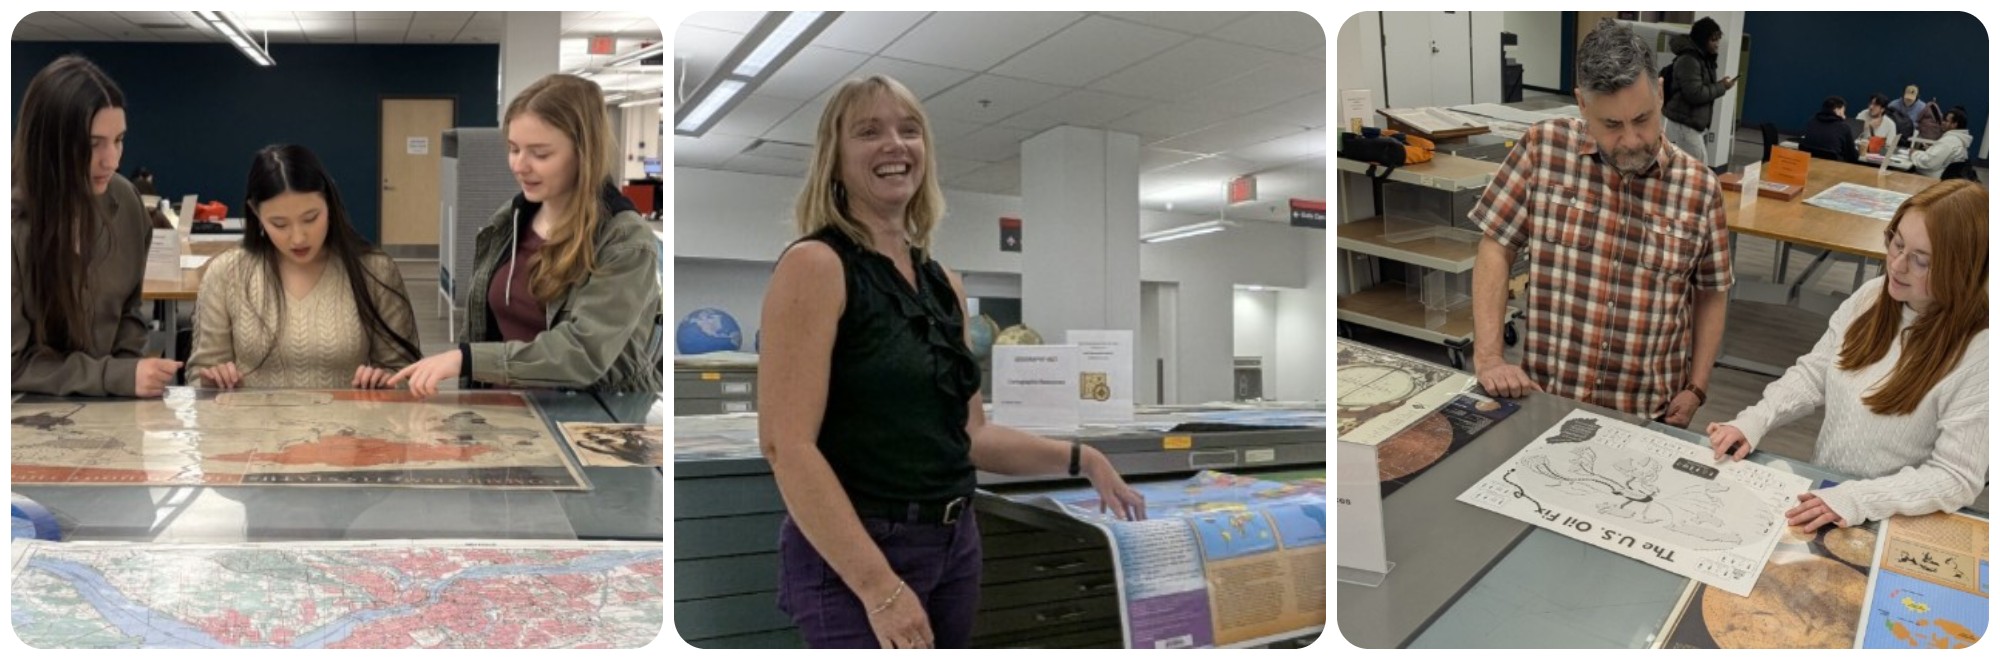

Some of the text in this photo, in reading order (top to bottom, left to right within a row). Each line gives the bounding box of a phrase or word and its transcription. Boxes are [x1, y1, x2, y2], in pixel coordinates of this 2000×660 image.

[1535, 507, 1676, 562] The U.S. Oil Fix
